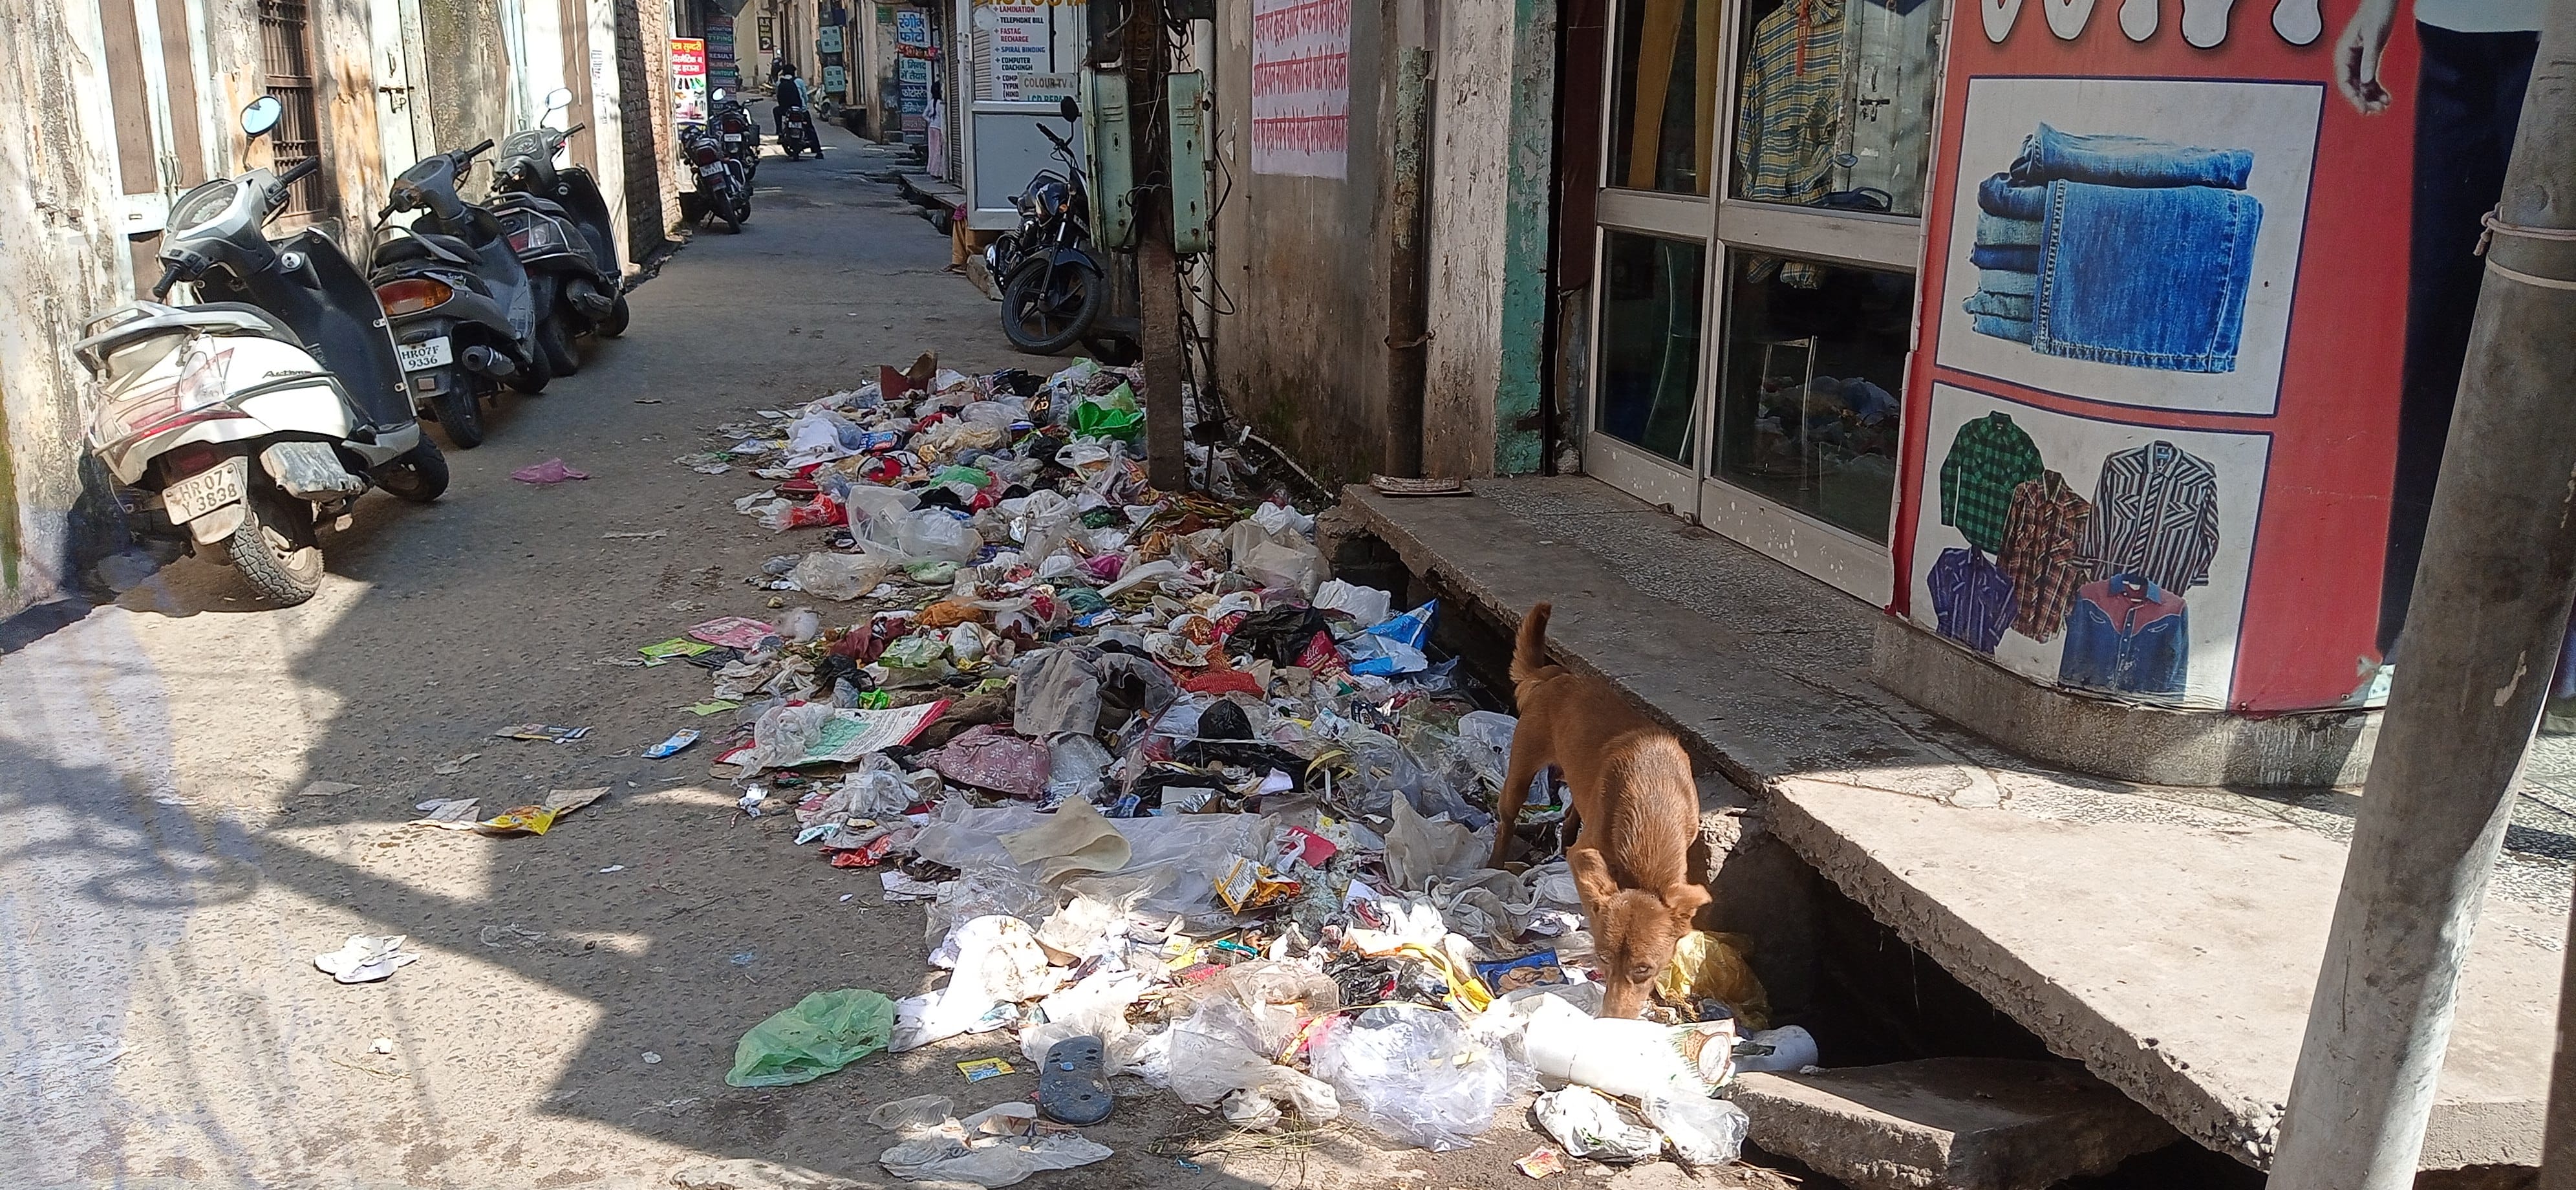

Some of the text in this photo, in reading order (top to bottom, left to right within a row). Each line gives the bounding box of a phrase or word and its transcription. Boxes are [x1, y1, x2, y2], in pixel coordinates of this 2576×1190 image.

[899, 28, 925, 43] फोटो
[1265, 12, 1274, 41] पर
[409, 356, 438, 368] 9336
[179, 470, 222, 501] HR 07
[182, 483, 237, 517] Y 3838
